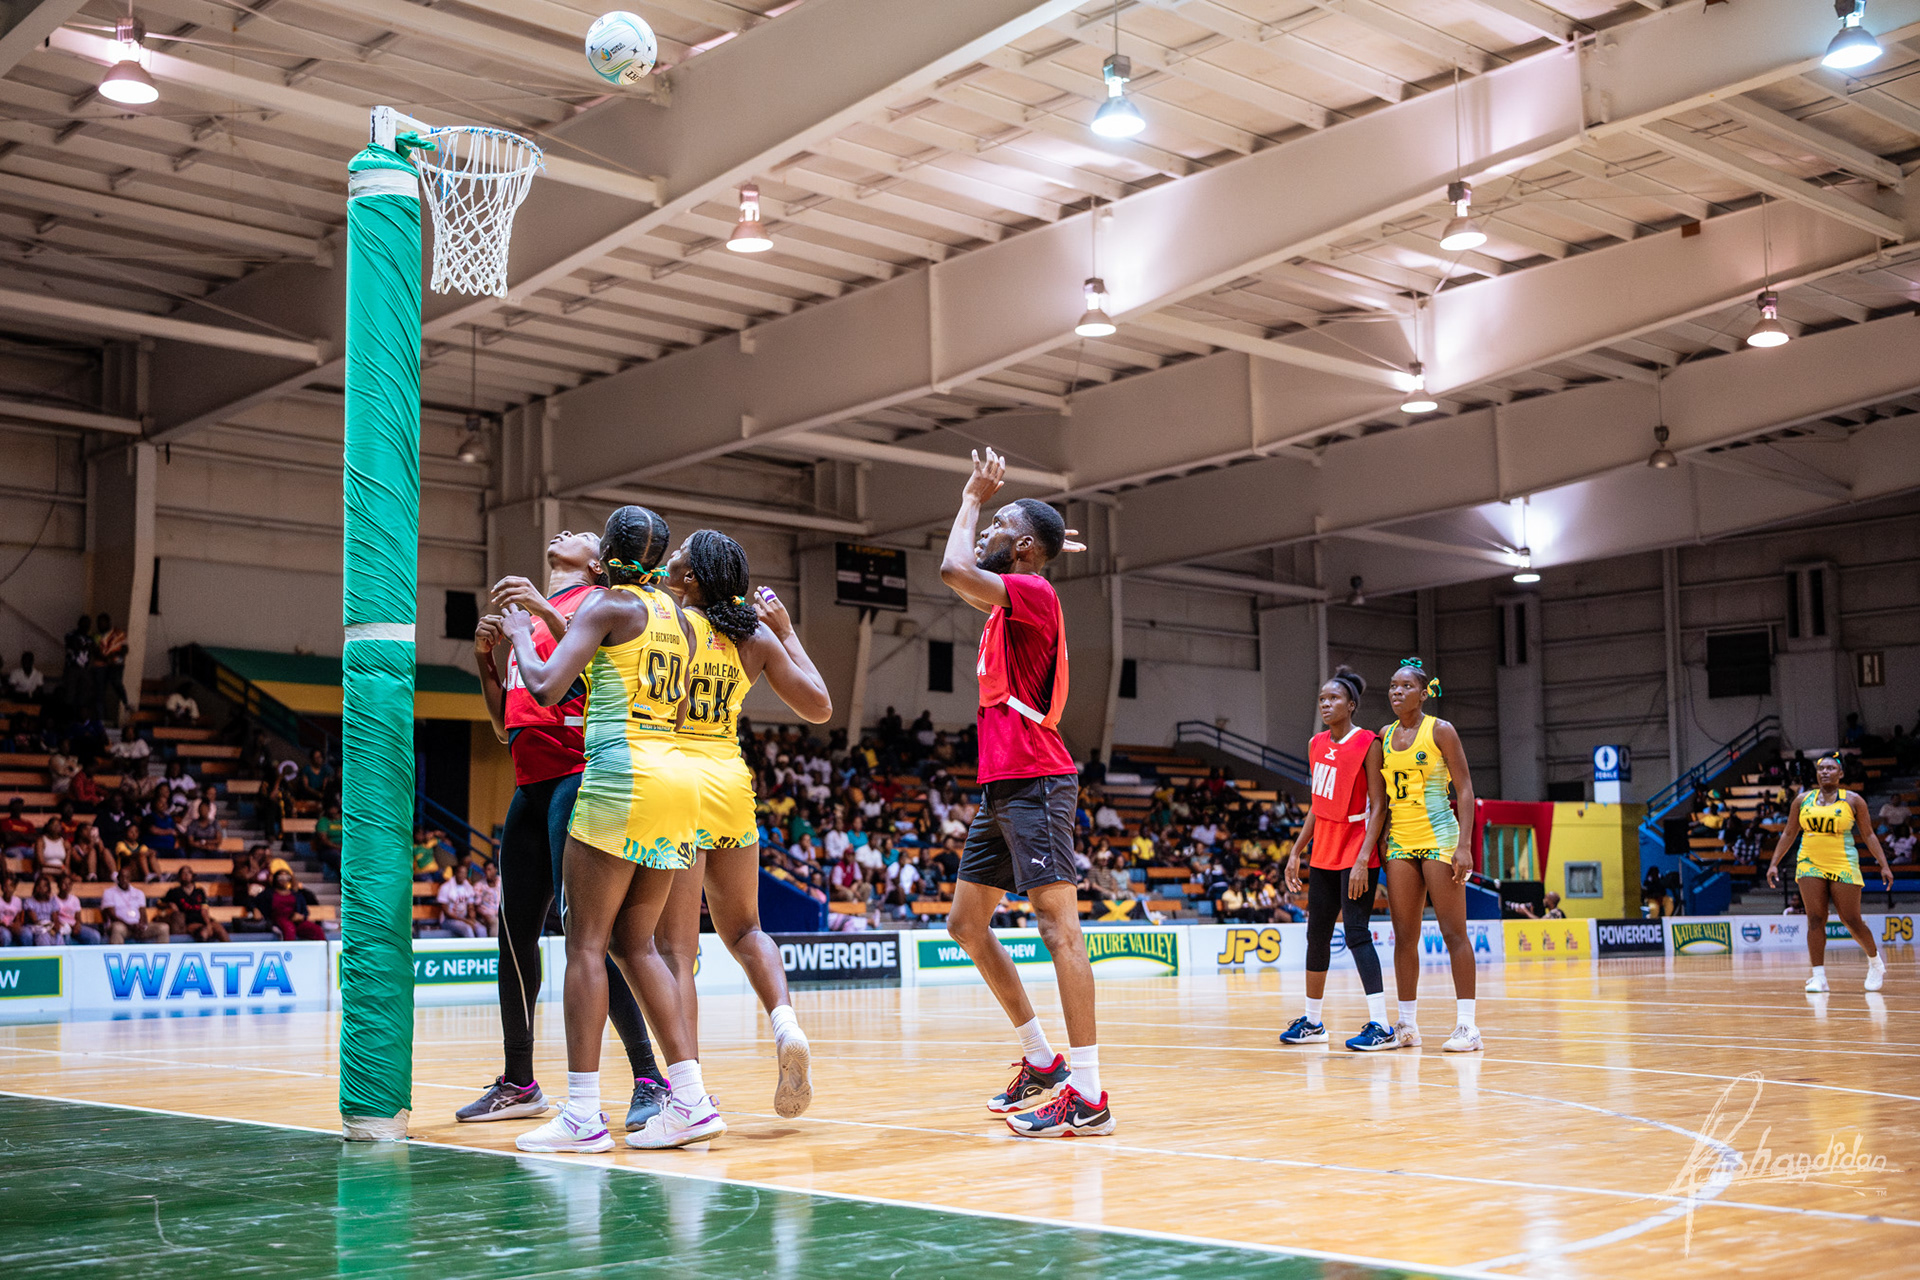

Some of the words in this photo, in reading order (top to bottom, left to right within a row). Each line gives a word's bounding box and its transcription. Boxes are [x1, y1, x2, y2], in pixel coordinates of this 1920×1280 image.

[656, 631, 680, 646] BECKFORD
[646, 649, 683, 705] GD
[686, 676, 739, 723] GK
[1311, 761, 1338, 801] WA
[1805, 817, 1836, 834] WA
[1599, 924, 1662, 945] POWERADE
[1673, 924, 1703, 949] NATURE
[1702, 922, 1729, 946] VALLEY
[1882, 916, 1913, 942] JPS
[778, 940, 897, 972] OWERADE
[937, 946, 971, 962] WRA
[1128, 933, 1174, 964] VALLEY
[1217, 927, 1282, 965] JPS
[425, 960, 440, 977] &
[443, 958, 499, 976] NEPHE
